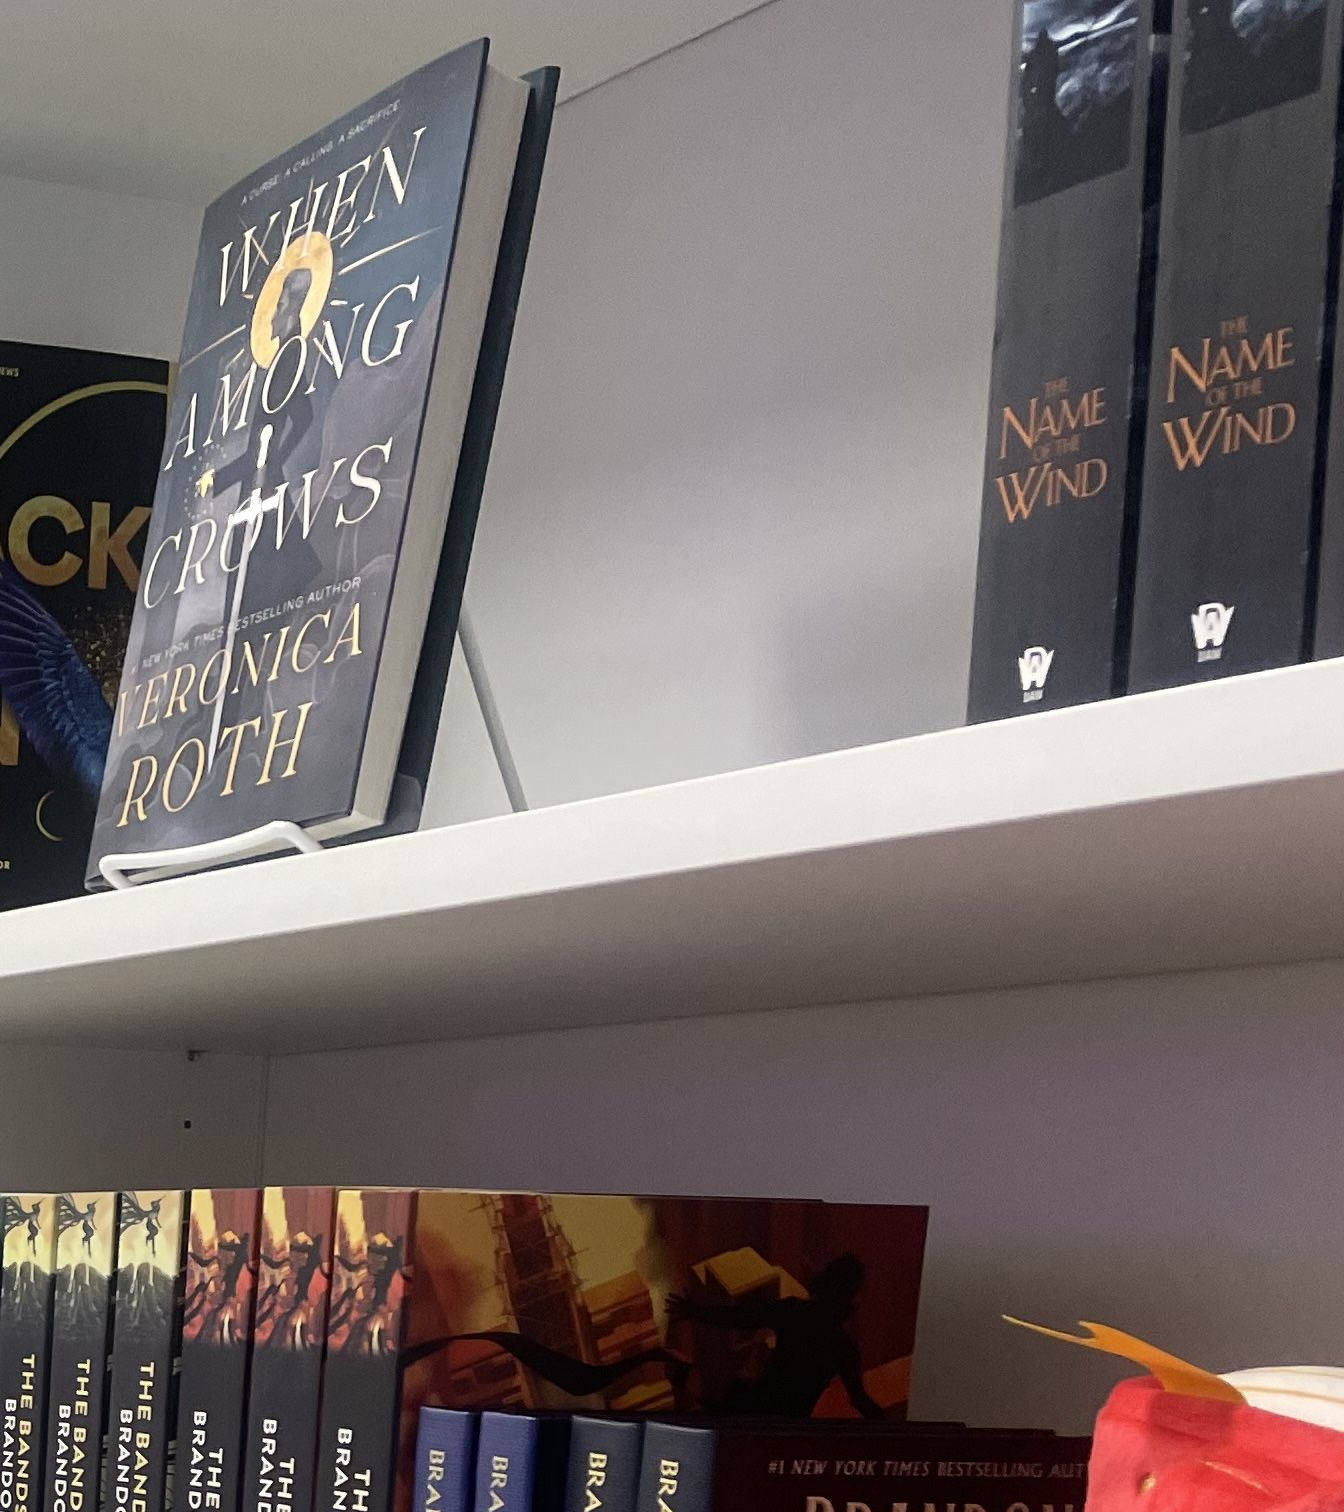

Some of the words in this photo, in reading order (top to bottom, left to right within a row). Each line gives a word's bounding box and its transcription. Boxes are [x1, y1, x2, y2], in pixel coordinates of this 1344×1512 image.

[220, 125, 427, 307] WHEN
[1220, 315, 1249, 336] THE
[163, 275, 420, 471] AMONG
[1167, 327, 1295, 403] NAME
[999, 387, 1108, 459] NAME
[1162, 402, 1296, 472] WIND
[143, 436, 393, 610] CROWS
[995, 457, 1109, 524] WIND
[194, 627, 225, 653] TIMES
[307, 575, 363, 602] AUTHOR
[118, 603, 363, 737] VERONICA
[116, 702, 313, 828] ROTH
[74, 1359, 91, 1418] THE
[790, 1460, 828, 1476] NEW
[834, 1460, 876, 1477] YORK
[882, 1460, 930, 1478] TIMES
[937, 1460, 1043, 1479] BESTSELLING
